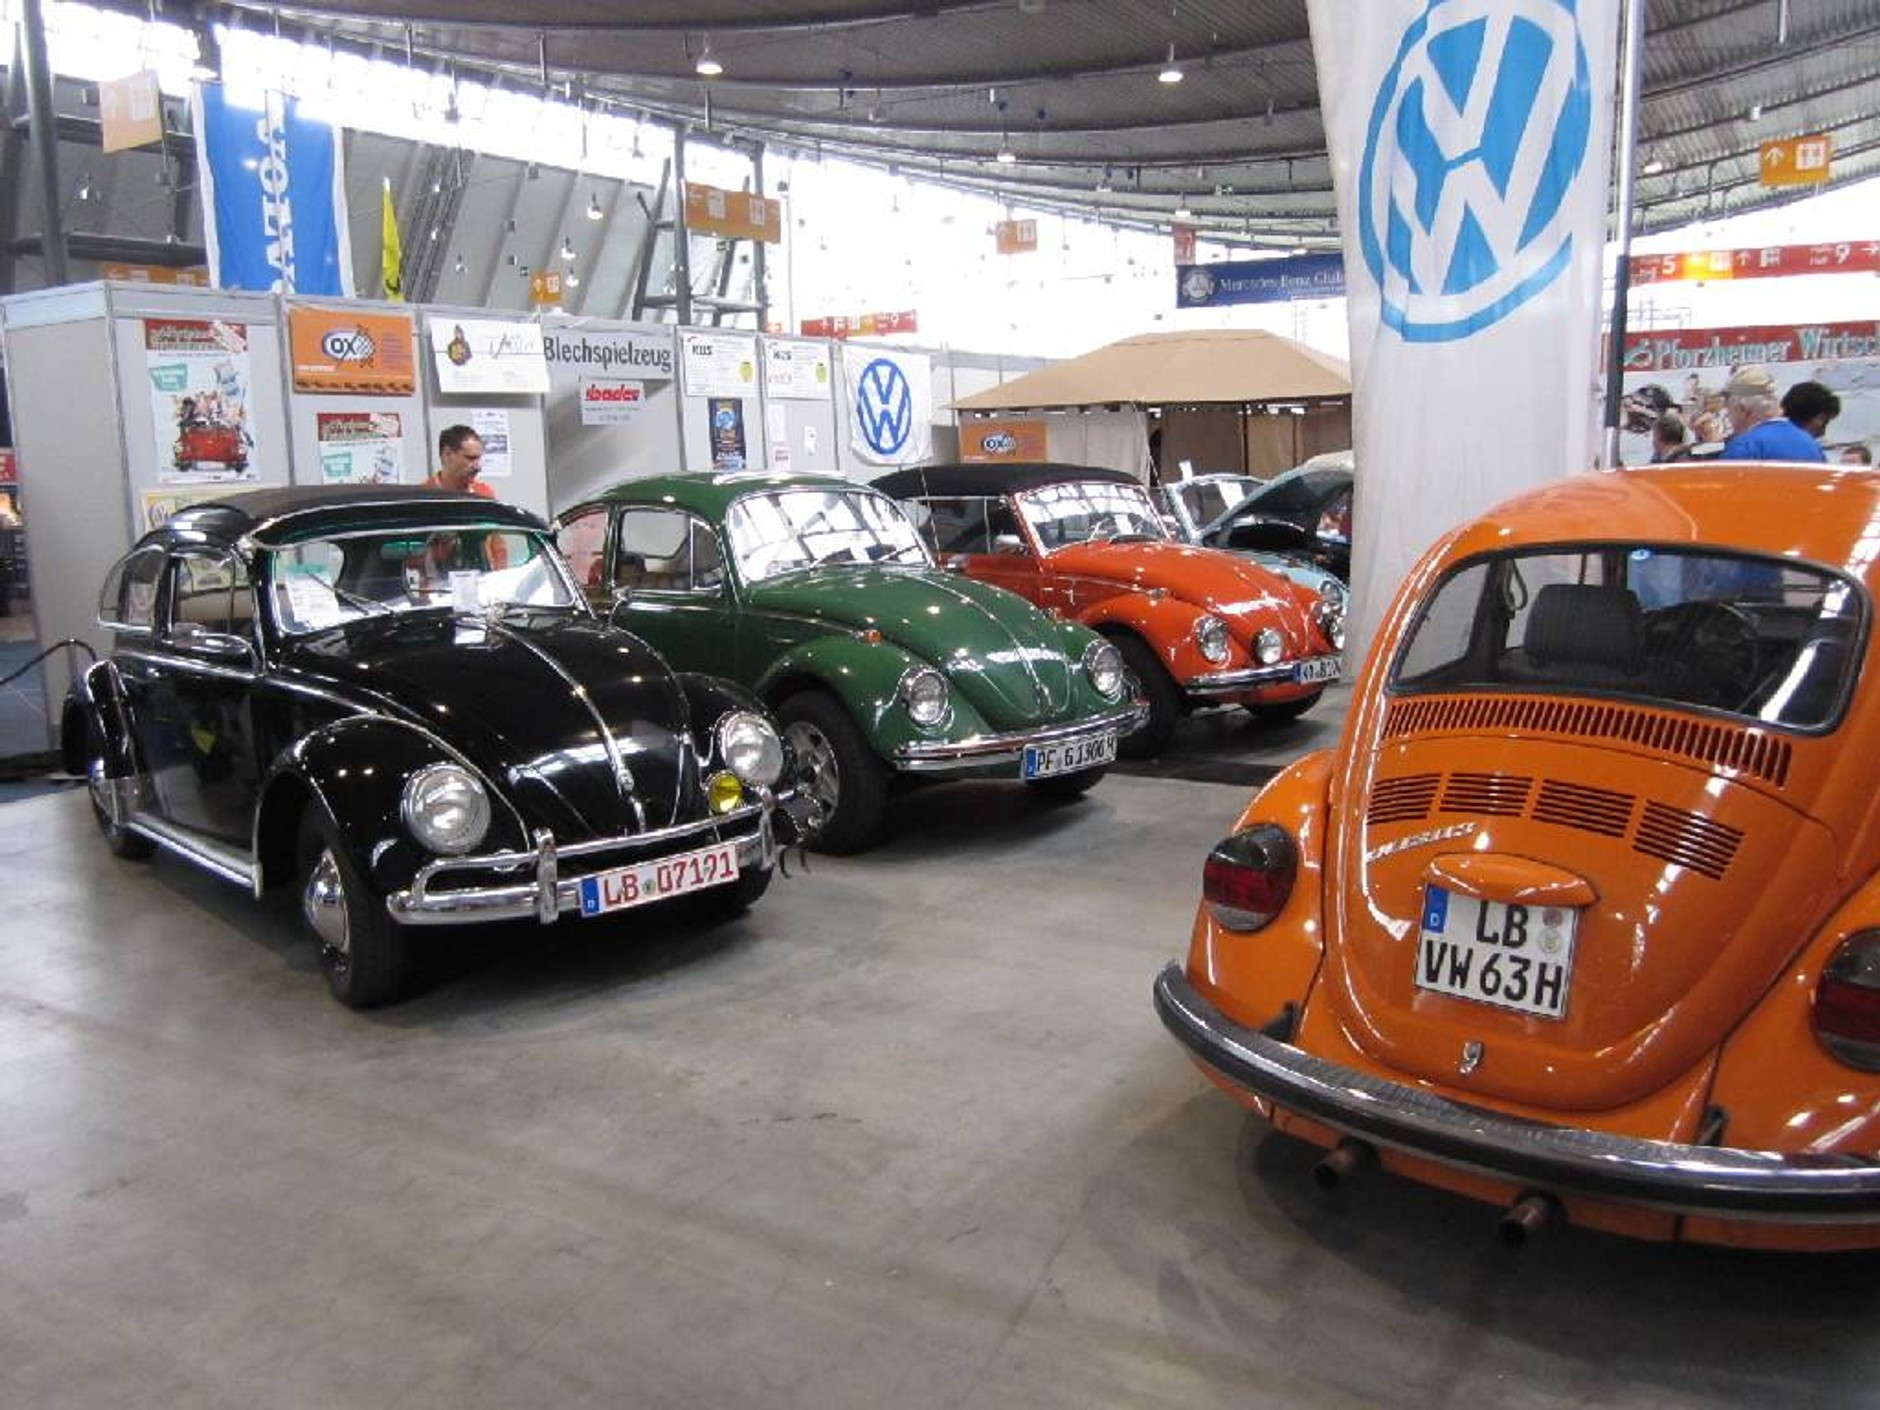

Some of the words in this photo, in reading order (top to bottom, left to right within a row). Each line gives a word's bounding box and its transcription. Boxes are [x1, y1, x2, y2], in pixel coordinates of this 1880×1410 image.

[1661, 255, 1676, 275] 5
[1836, 244, 1851, 265] 9
[543, 336, 673, 374] Blechspielzeug
[1653, 333, 1792, 369] Pforzheimer
[603, 872, 640, 907] LB
[1476, 899, 1530, 949] LB
[1425, 939, 1474, 990] VW
